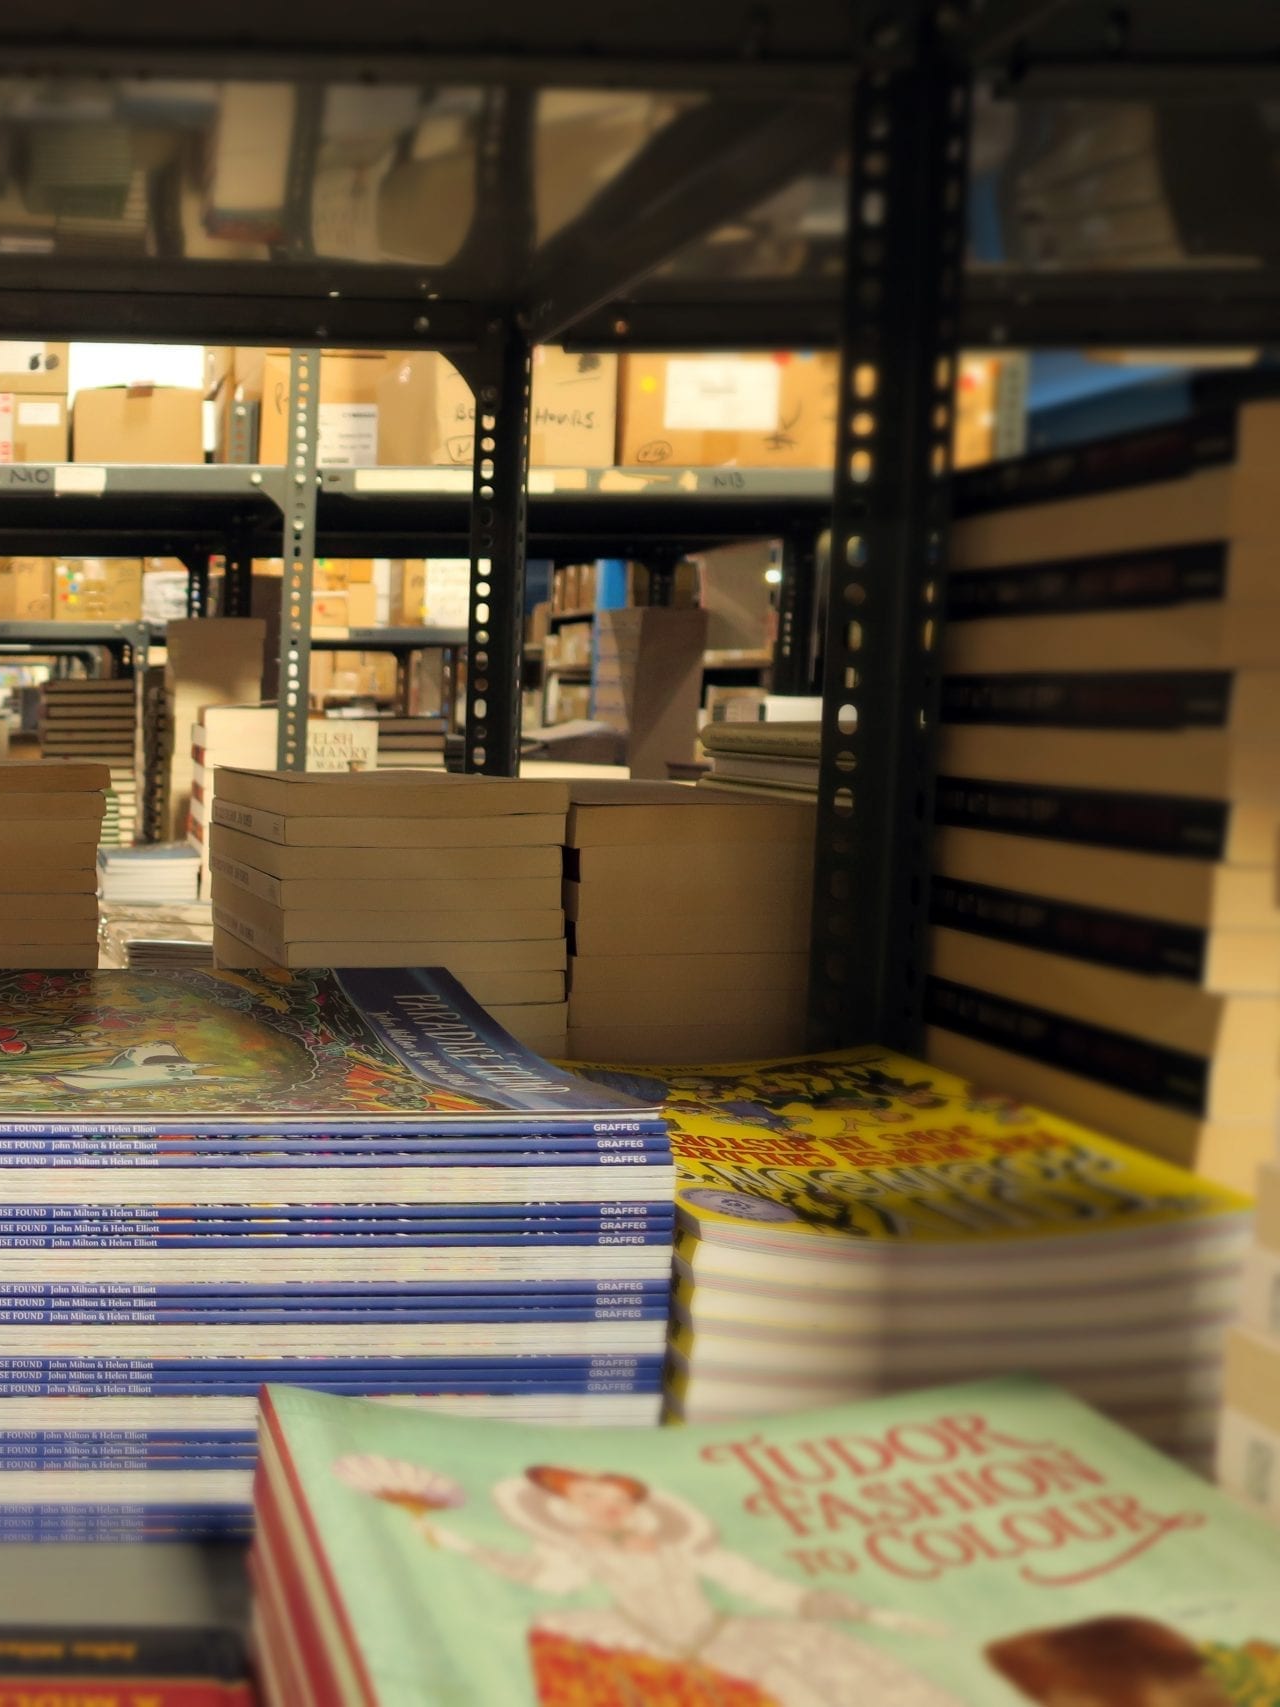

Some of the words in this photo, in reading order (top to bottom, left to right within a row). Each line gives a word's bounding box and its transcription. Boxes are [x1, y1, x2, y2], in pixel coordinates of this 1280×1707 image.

[393, 994, 504, 1061] PARADISE
[466, 1064, 571, 1094] FOUND
[14, 1124, 45, 1133] FOUND
[50, 1124, 70, 1134] John
[71, 1125, 98, 1133] Milton
[107, 1125, 131, 1133] Helen
[132, 1125, 156, 1133] Elliott
[594, 1123, 640, 1132] GRAFFEG
[876, 1125, 977, 1142] JOBS
[15, 1140, 46, 1148] FOUND
[50, 1140, 71, 1150] John
[72, 1141, 99, 1149] Milton
[108, 1141, 131, 1149] Helen
[133, 1141, 157, 1149] Elliott
[597, 1140, 644, 1148] GRAFFEG
[820, 1135, 866, 1152] IN
[846, 1141, 976, 1167] WORST
[16, 1157, 47, 1165] FOUND
[52, 1157, 73, 1166] John
[74, 1157, 100, 1165] Milton
[110, 1157, 133, 1166] Helen
[135, 1157, 159, 1166] Elliott
[600, 1155, 647, 1163] GRAFFEG
[15, 1209, 47, 1217] FOUND
[51, 1209, 72, 1218] John
[73, 1209, 100, 1217] Milton
[109, 1209, 133, 1217] Helen
[135, 1209, 159, 1218] Elliott
[600, 1207, 647, 1215] GRAFFEG
[17, 1224, 48, 1232] FOUND
[52, 1224, 73, 1234] John
[74, 1224, 101, 1233] Milton
[110, 1224, 134, 1233] Helen
[135, 1224, 160, 1233] Elliott
[600, 1222, 647, 1230] GRAFFEG
[14, 1238, 46, 1247] FOUND
[50, 1239, 71, 1248] John
[72, 1239, 99, 1247] Milton
[108, 1239, 132, 1247] Helen
[133, 1239, 158, 1247] Elliott
[598, 1236, 645, 1244] GRAFFEG
[14, 1285, 45, 1294] FOUND
[49, 1286, 70, 1295] John
[71, 1286, 98, 1294] Milton
[107, 1286, 130, 1294] Helen
[132, 1286, 156, 1294] Elliott
[596, 1282, 643, 1290] GRAFFEG
[14, 1299, 45, 1307] FOUND
[50, 1299, 71, 1308] John
[72, 1299, 98, 1307] Milton
[107, 1299, 131, 1307] Helen
[133, 1299, 157, 1308] Elliott
[596, 1297, 642, 1305] GRAFFEG
[13, 1312, 44, 1320] FOUND
[49, 1312, 69, 1321] John
[70, 1312, 97, 1321] Milton
[106, 1312, 130, 1321] Helen
[131, 1312, 155, 1321] Elliott
[595, 1310, 641, 1318] GRAFFEG
[12, 1360, 43, 1368] FOUND
[47, 1360, 68, 1370] John
[69, 1361, 95, 1369] Milton
[105, 1361, 128, 1369] Helen
[130, 1361, 154, 1369] Elliott
[591, 1359, 637, 1367] GRAFFEG
[12, 1371, 42, 1380] FOUND
[47, 1372, 67, 1381] John
[68, 1372, 95, 1380] Milton
[104, 1372, 127, 1380] Helen
[129, 1372, 153, 1380] Elliott
[589, 1369, 635, 1377] GRAFFEG
[10, 1385, 41, 1393] FOUND
[46, 1385, 66, 1394] John
[67, 1385, 93, 1393] Milton
[102, 1385, 126, 1393] Helen
[127, 1385, 151, 1393] Elliott
[587, 1383, 633, 1391] GRAFFEG
[701, 1413, 1058, 1491] TUDOR
[742, 1448, 1107, 1539] FASHION
[864, 1494, 1208, 1588] COLOUR
